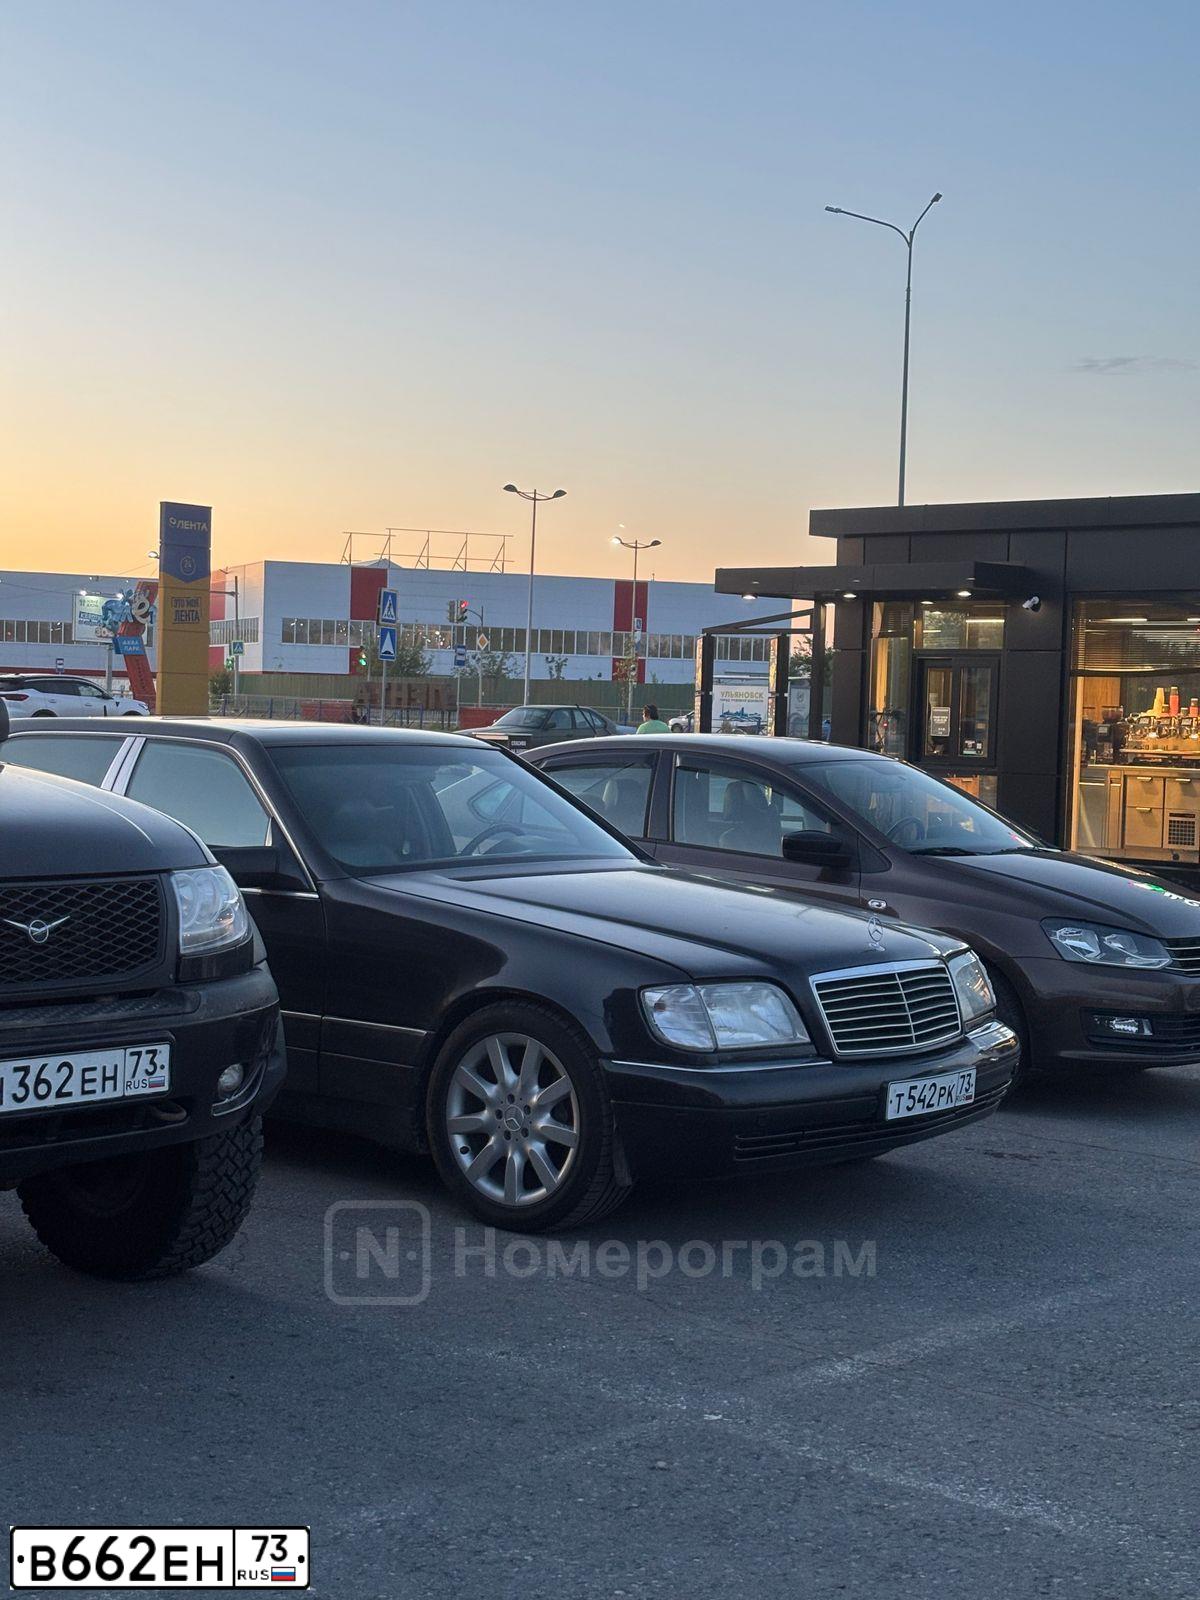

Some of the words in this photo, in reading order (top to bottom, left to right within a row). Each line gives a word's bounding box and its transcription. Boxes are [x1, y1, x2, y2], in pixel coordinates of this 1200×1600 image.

[176, 519, 209, 532] ЛЕНТА
[173, 598, 185, 609] ЭТО
[174, 609, 201, 622] ЛЕНТА
[719, 690, 764, 699] УЛЬЯНОВСК
[0, 1061, 118, 1106] 362ЕН
[129, 1049, 158, 1079] 73
[125, 1079, 148, 1091] RUS
[895, 1082, 956, 1114] Т542РК
[959, 1073, 972, 1095] 73
